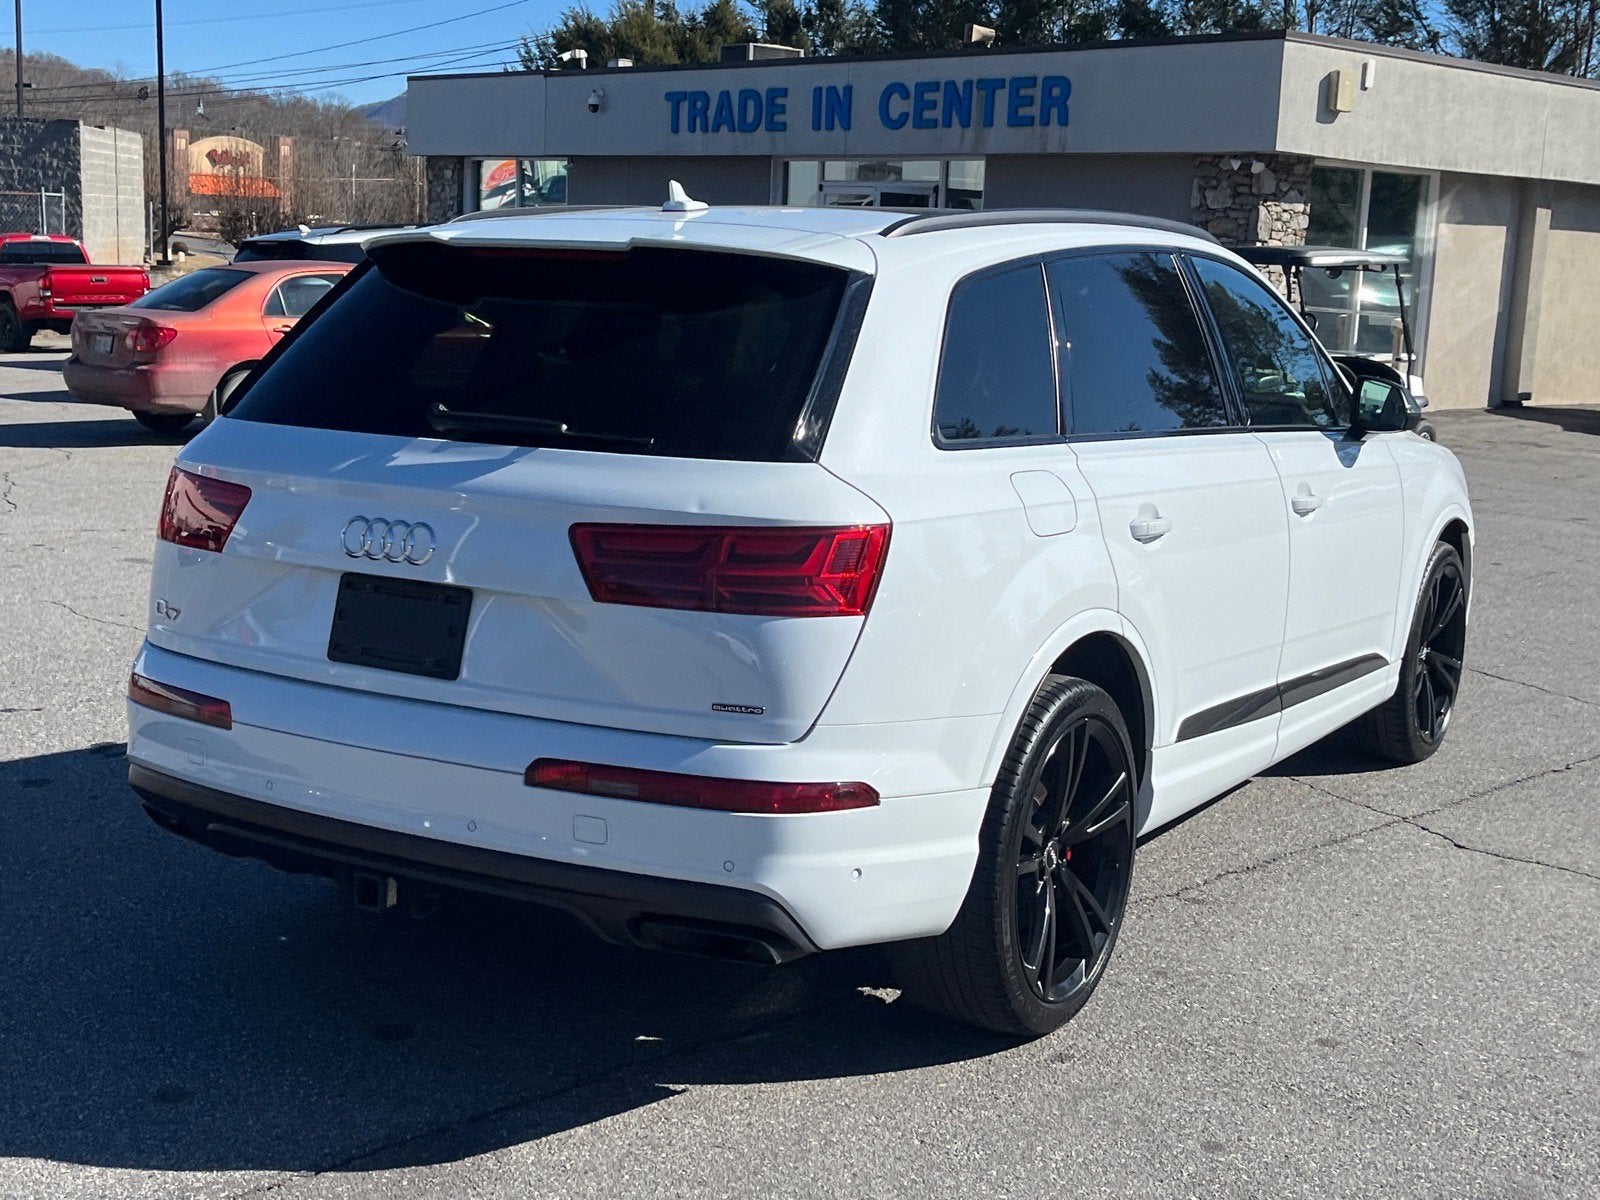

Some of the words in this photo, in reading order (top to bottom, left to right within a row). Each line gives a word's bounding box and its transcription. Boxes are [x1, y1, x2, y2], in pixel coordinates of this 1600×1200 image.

[665, 87, 788, 133] TRADE
[811, 84, 853, 131] IN
[878, 75, 1072, 130] CENTER
[712, 704, 763, 714] quattro
